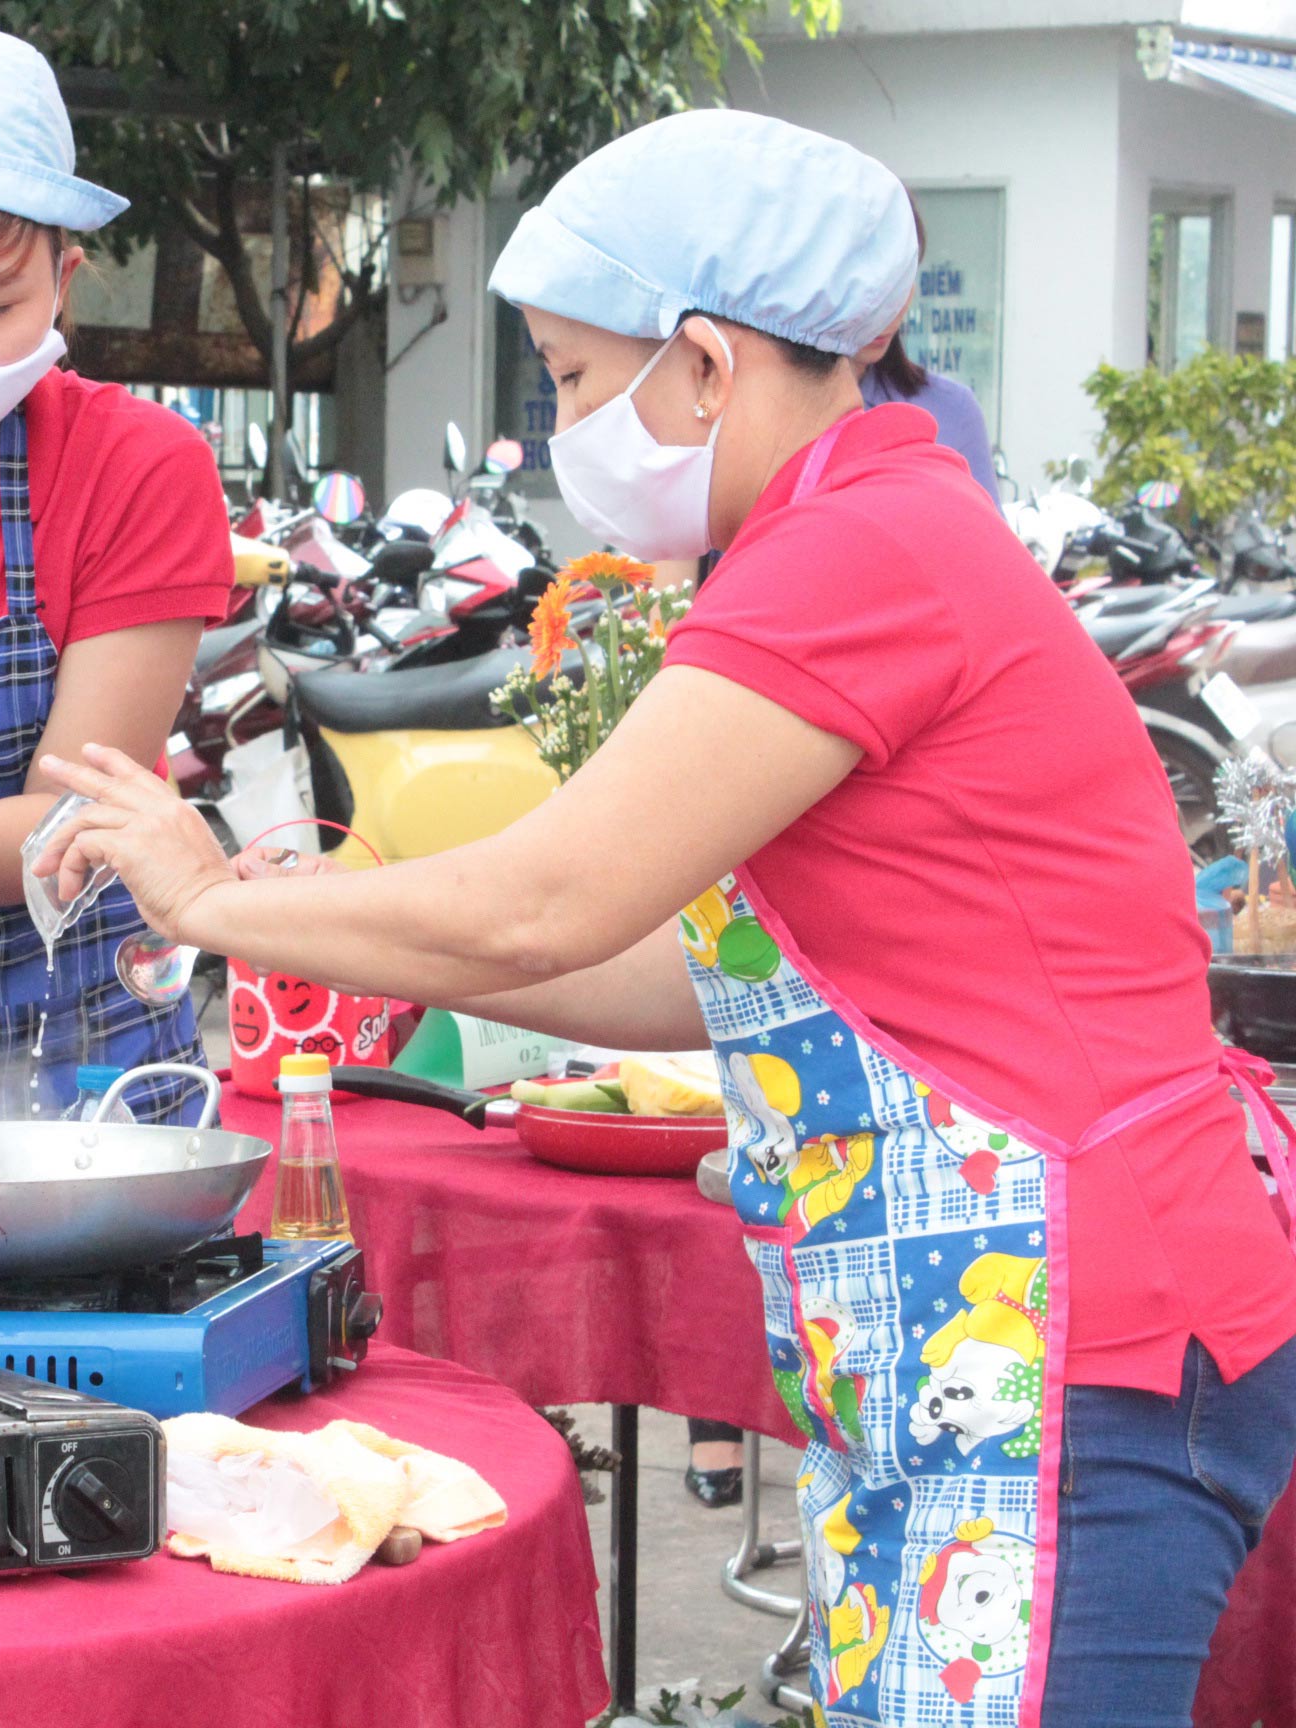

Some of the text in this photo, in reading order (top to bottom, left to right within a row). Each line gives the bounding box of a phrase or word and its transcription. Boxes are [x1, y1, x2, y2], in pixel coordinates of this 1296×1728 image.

[931, 308, 976, 334] DANH
[519, 1045, 542, 1063] 02
[61, 1442, 78, 1453] OFF
[58, 1545, 71, 1555] ON
